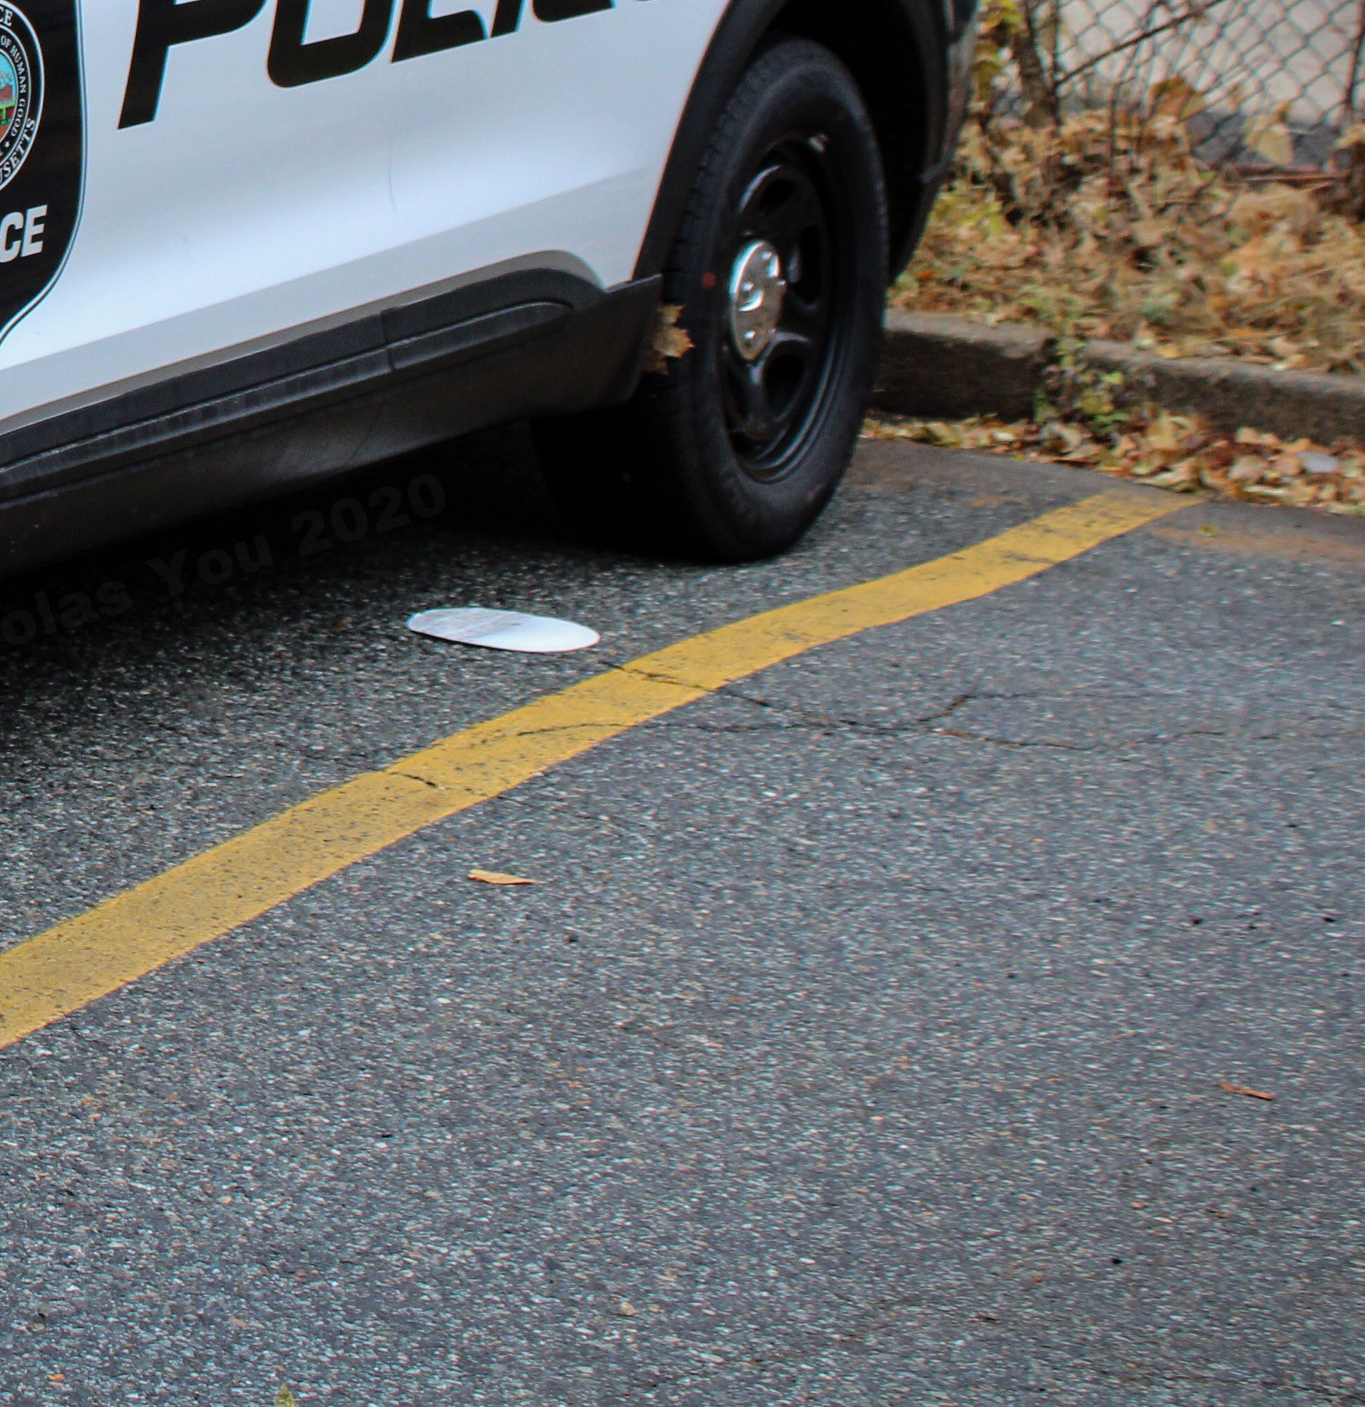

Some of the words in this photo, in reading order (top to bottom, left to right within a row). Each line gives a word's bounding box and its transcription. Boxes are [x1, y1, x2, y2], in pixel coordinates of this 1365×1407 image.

[0, 35, 12, 48] OF
[10, 43, 27, 93] HUMAN
[11, 98, 26, 138] GOOD
